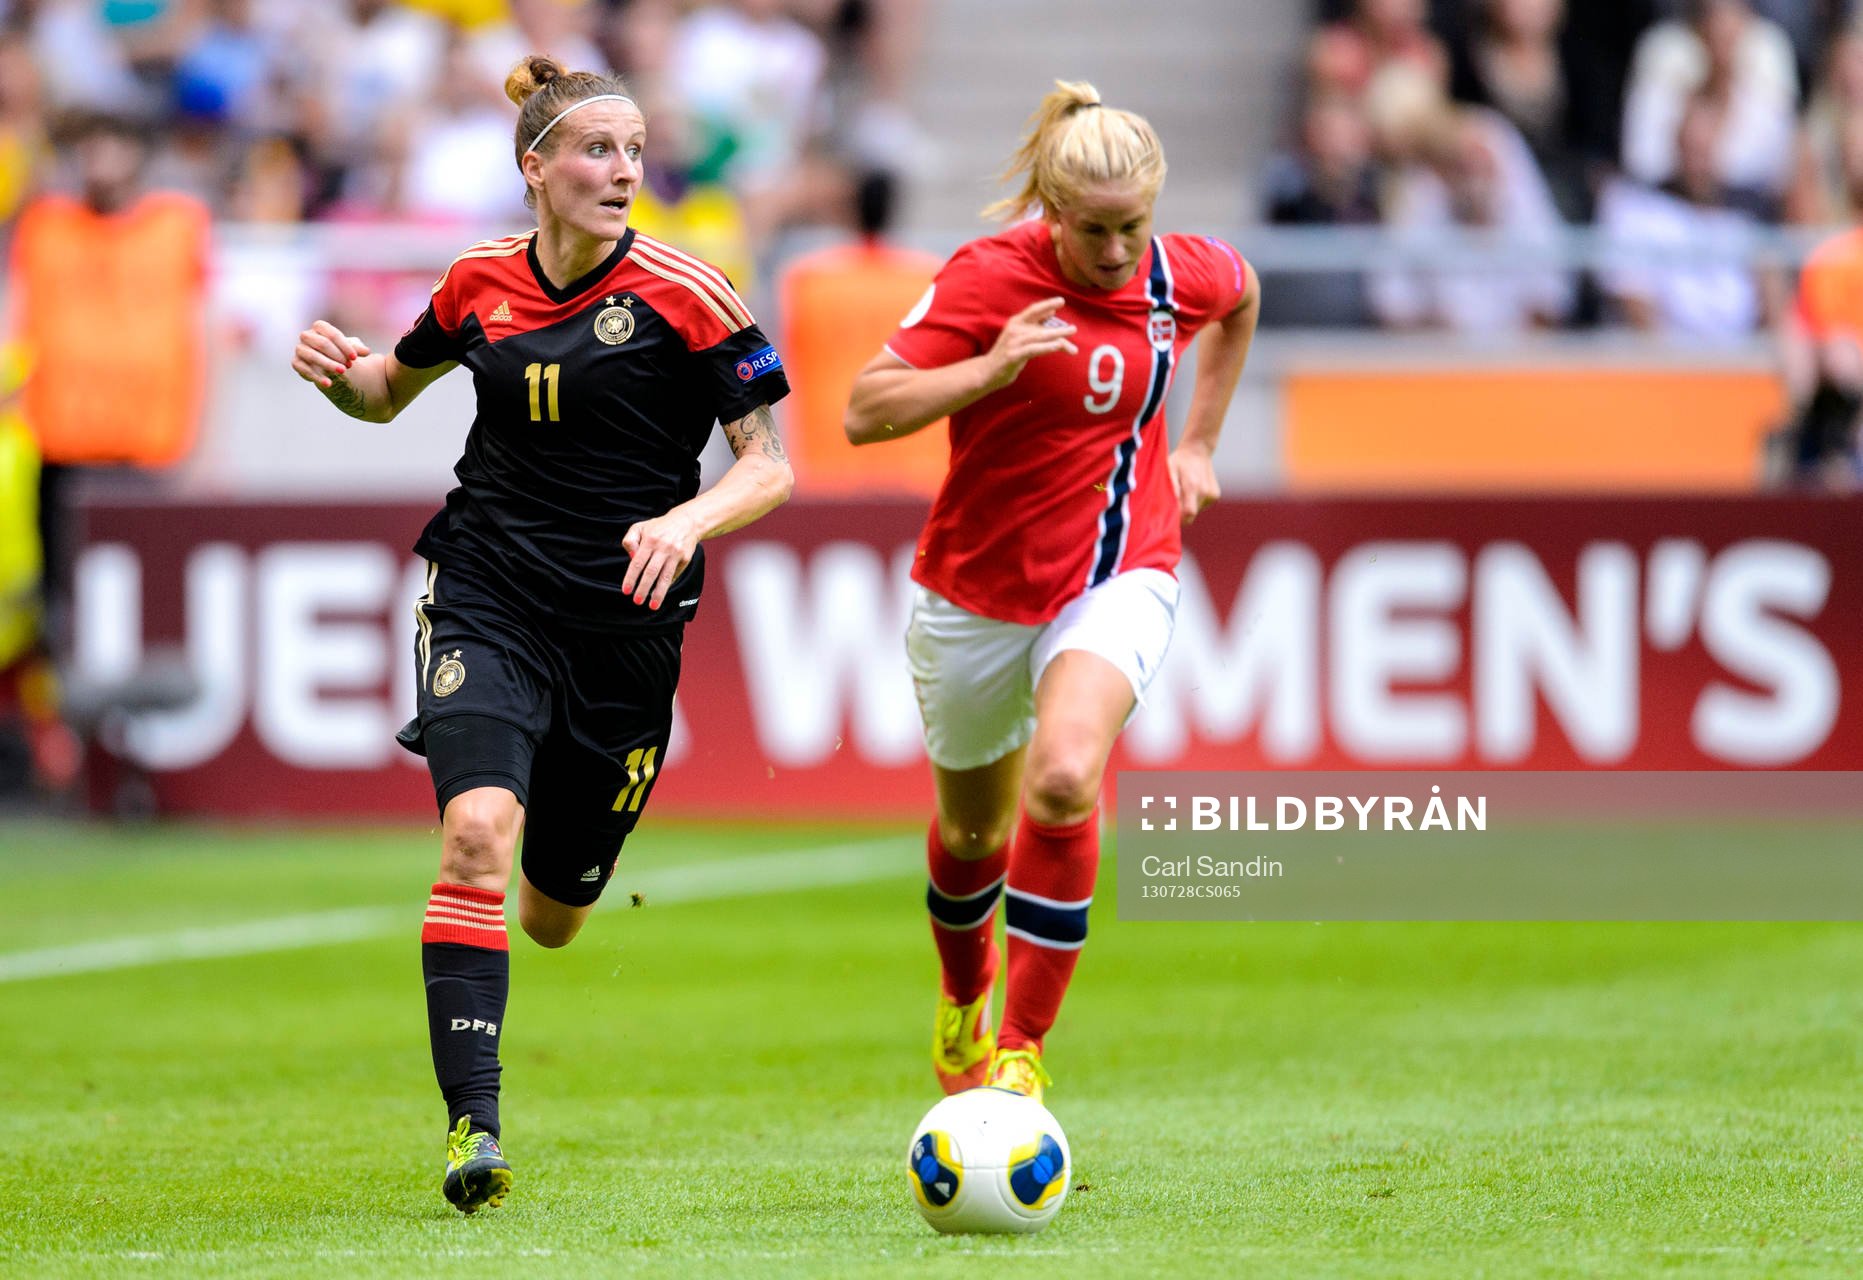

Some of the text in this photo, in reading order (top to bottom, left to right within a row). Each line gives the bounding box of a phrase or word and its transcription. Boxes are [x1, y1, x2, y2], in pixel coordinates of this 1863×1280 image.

[524, 363, 561, 422] 11
[1083, 344, 1125, 415] 9
[726, 540, 1841, 768] WMEN'S
[612, 746, 658, 812] 11
[450, 1018, 497, 1037] DFB
